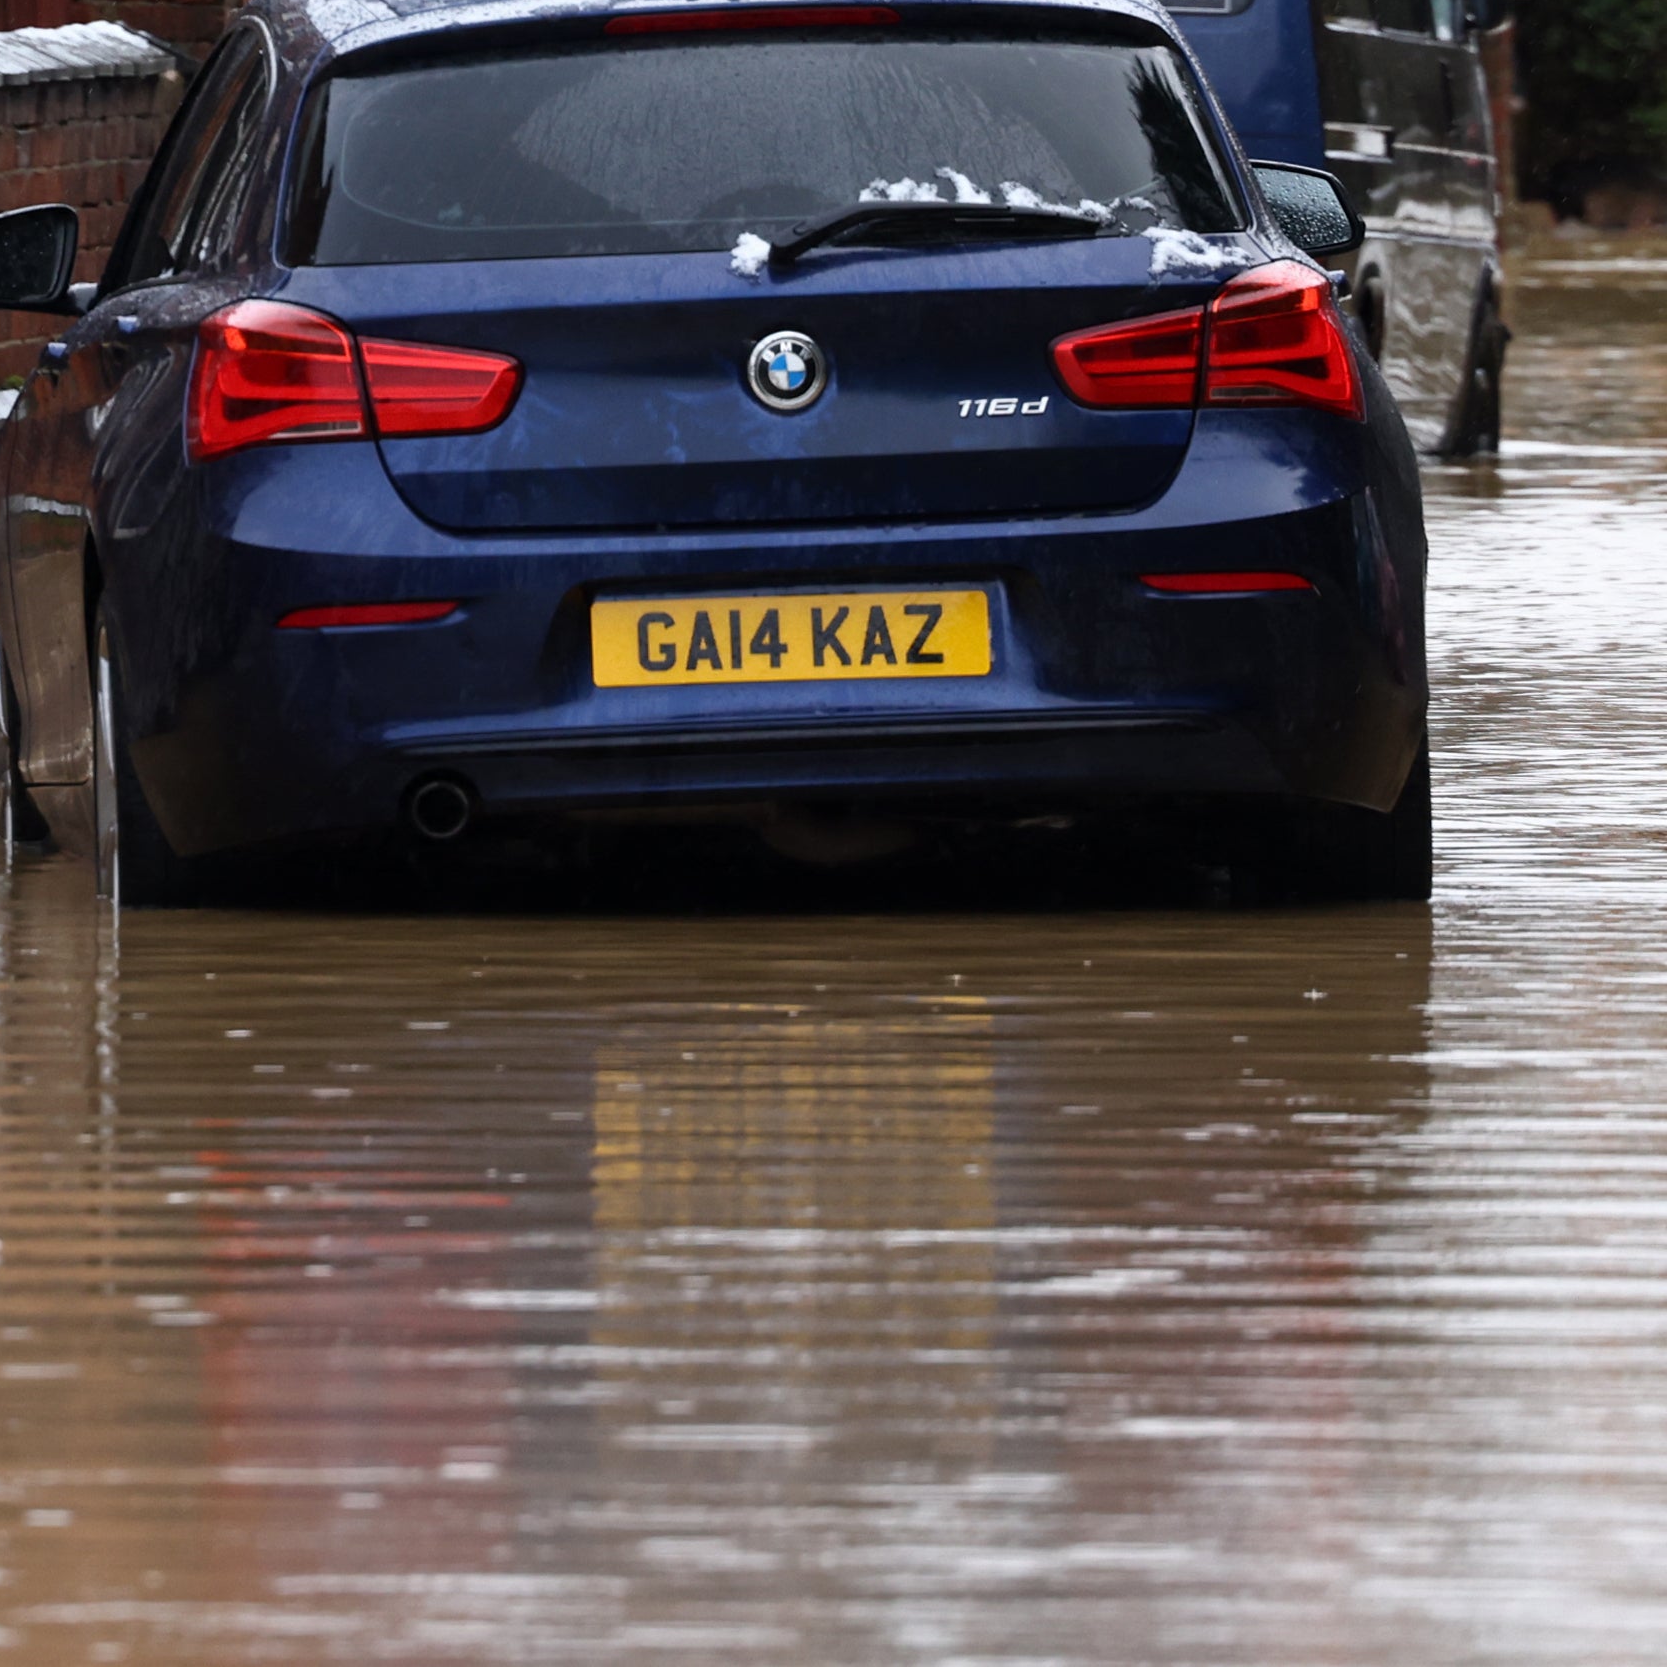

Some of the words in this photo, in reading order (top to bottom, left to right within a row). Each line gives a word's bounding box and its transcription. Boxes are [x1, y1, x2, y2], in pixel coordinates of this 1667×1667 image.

[761, 340, 814, 363] BMW
[958, 395, 1049, 418] 116d
[636, 608, 788, 673] GA14
[811, 603, 944, 668] KAZ
